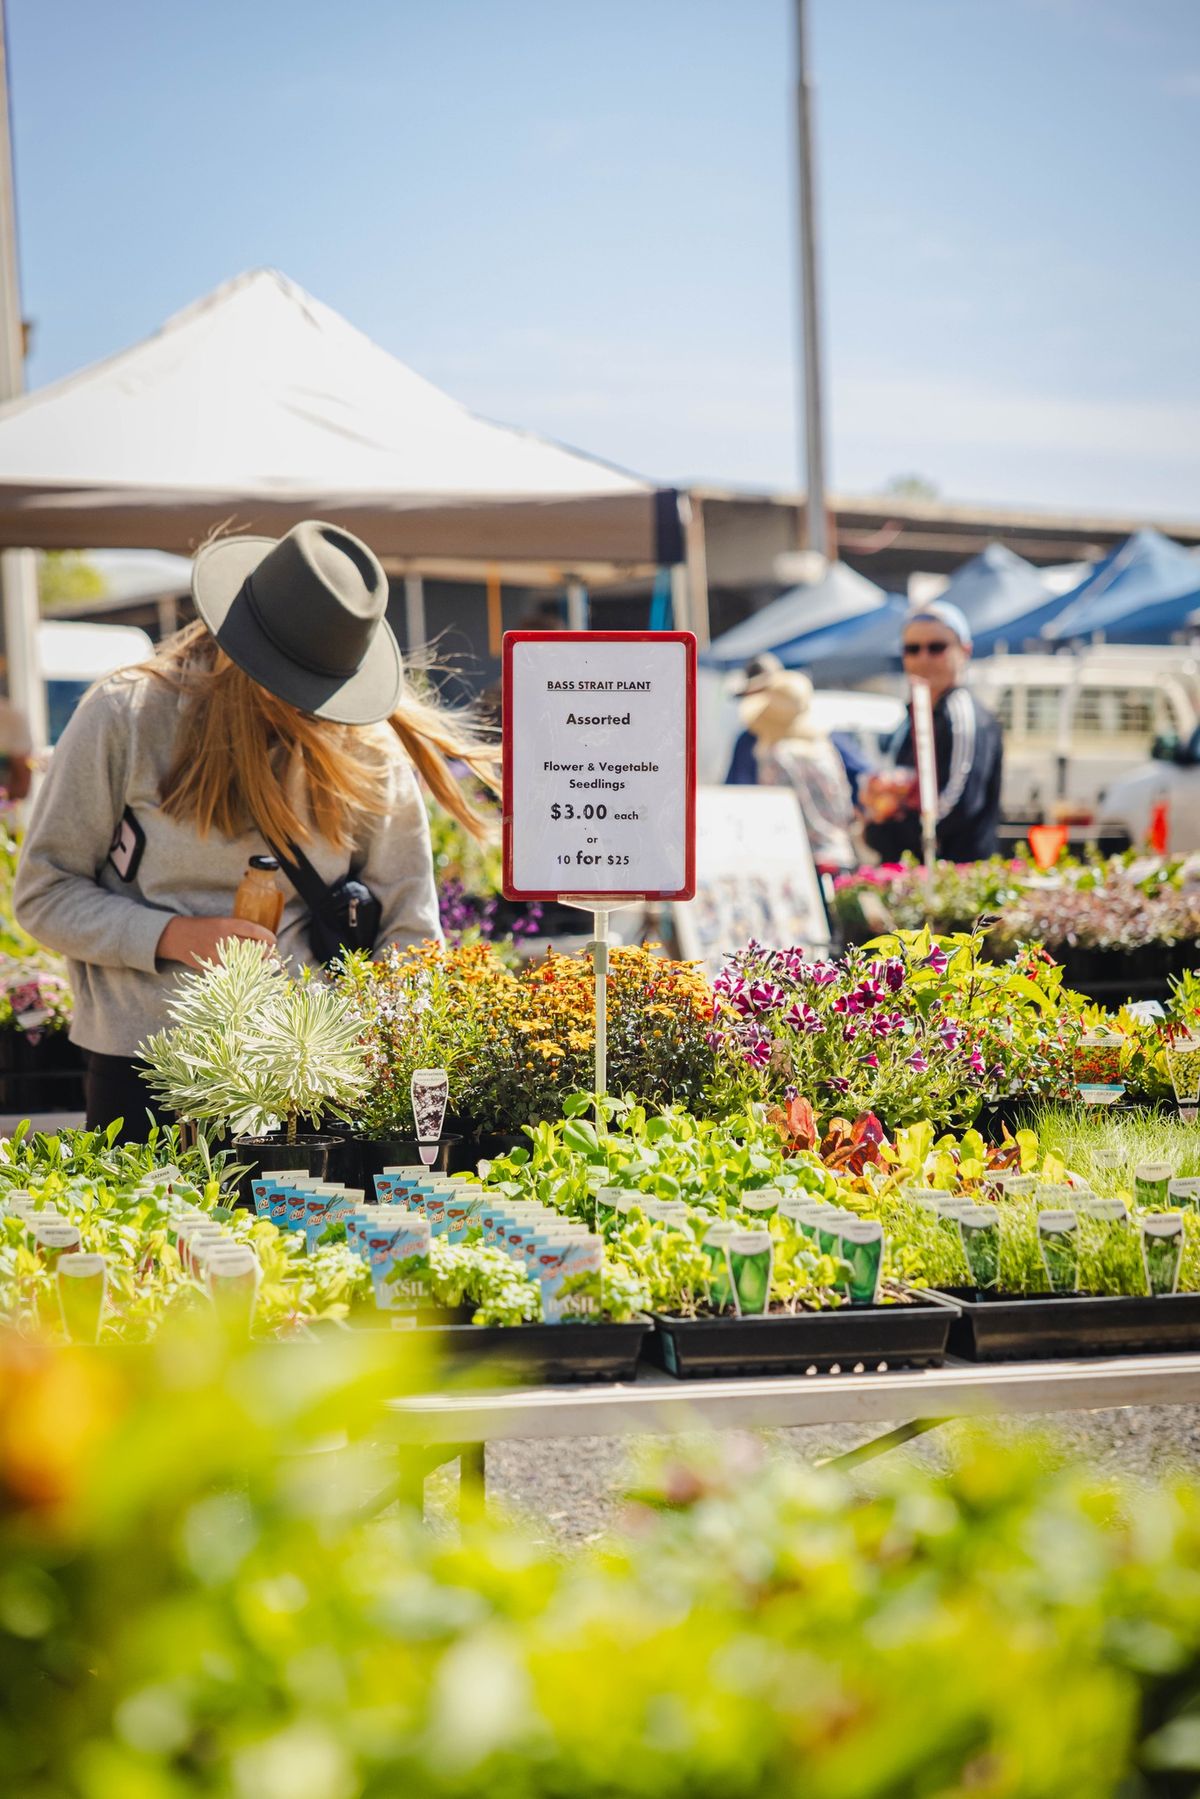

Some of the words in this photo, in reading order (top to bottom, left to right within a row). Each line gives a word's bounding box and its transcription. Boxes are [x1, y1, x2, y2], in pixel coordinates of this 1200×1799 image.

[547, 680, 575, 691] BASS
[578, 680, 614, 691] STRAIT
[616, 680, 652, 691] PLANT
[566, 713, 631, 726] Assorted
[543, 761, 584, 773] Flower
[588, 762, 595, 772] &
[599, 761, 659, 775] Vegetable
[569, 778, 626, 792] Seedlings
[550, 802, 608, 821] $3.00
[614, 811, 639, 821] each
[587, 836, 599, 845] or
[557, 855, 571, 866] 10
[576, 850, 602, 865] for
[607, 855, 630, 866] $25
